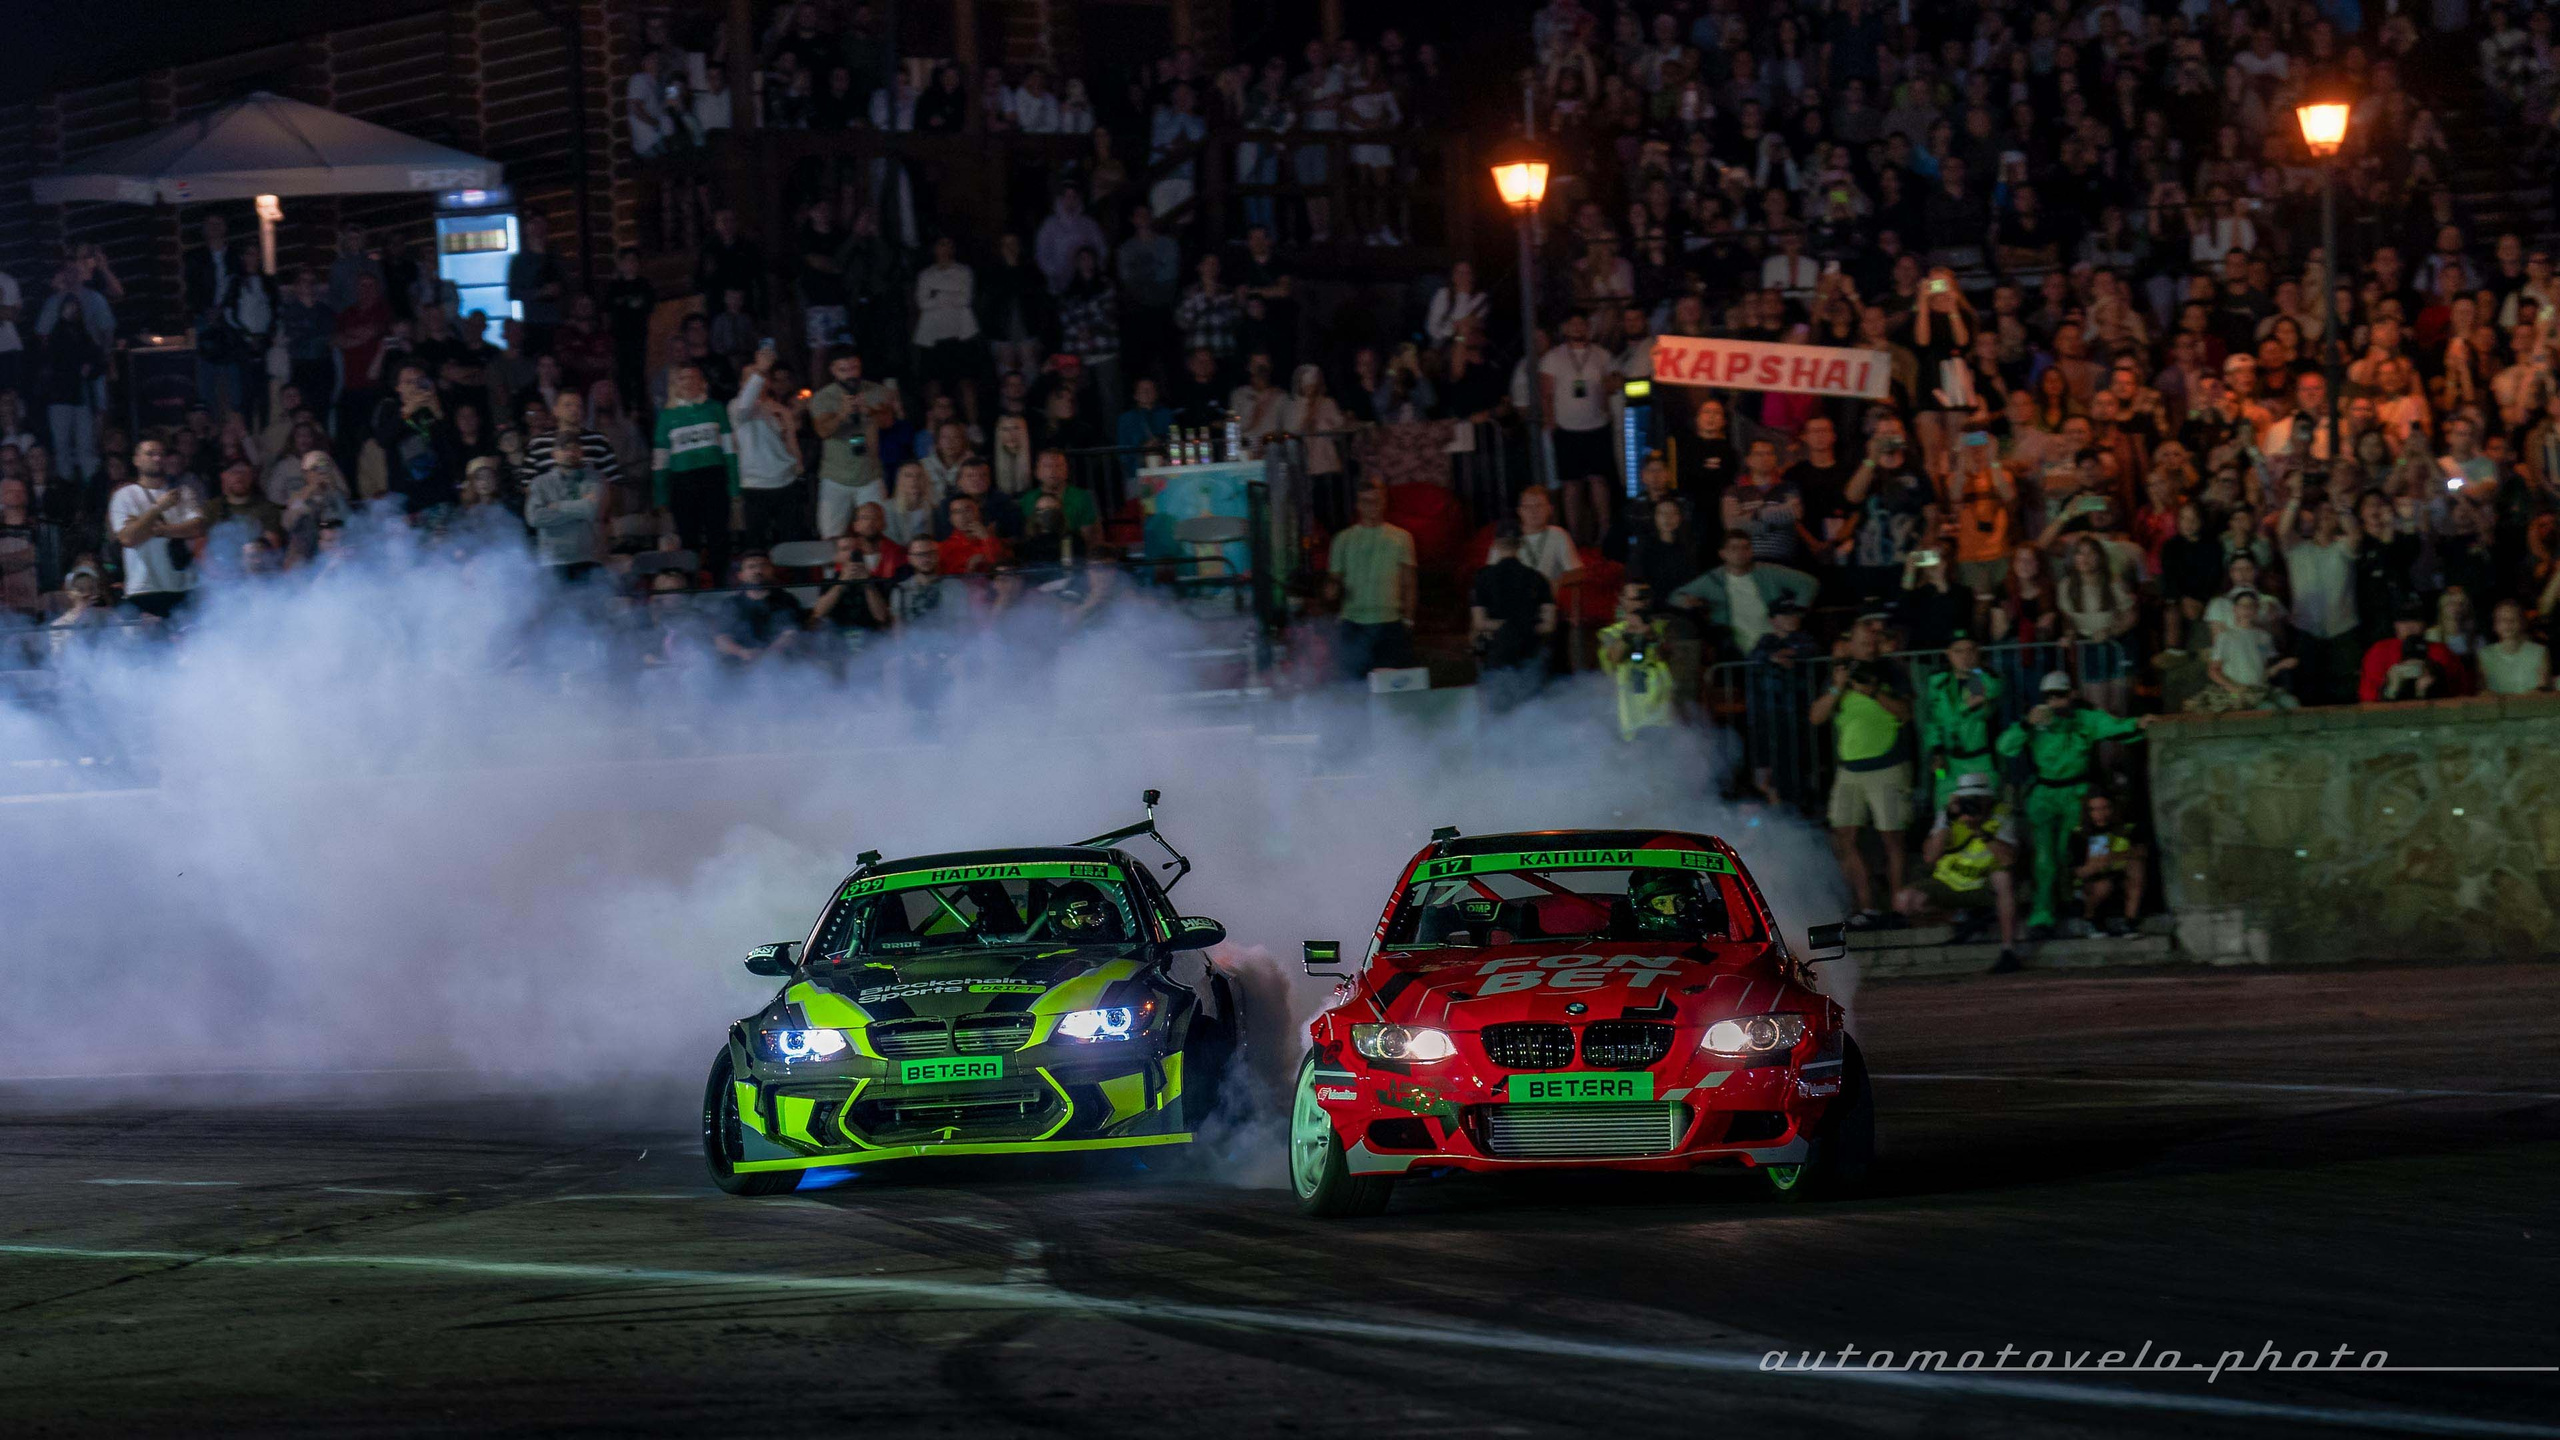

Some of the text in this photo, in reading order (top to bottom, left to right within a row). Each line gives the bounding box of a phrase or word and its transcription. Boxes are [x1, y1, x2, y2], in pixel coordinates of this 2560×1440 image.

[1657, 347, 1872, 392] KAPSHAI
[1439, 860, 1463, 873] 17
[1519, 851, 1634, 866] КАПШАЙ
[931, 865, 1021, 881] НАГУЛА
[850, 879, 883, 894] 999
[1411, 881, 1469, 906] 17
[1467, 904, 1491, 913] OMP
[882, 940, 921, 949] BRIDE
[1475, 954, 1679, 976] FON
[860, 977, 1028, 997] Blockchain
[1476, 968, 1682, 996] BET
[858, 984, 963, 1004] Sports
